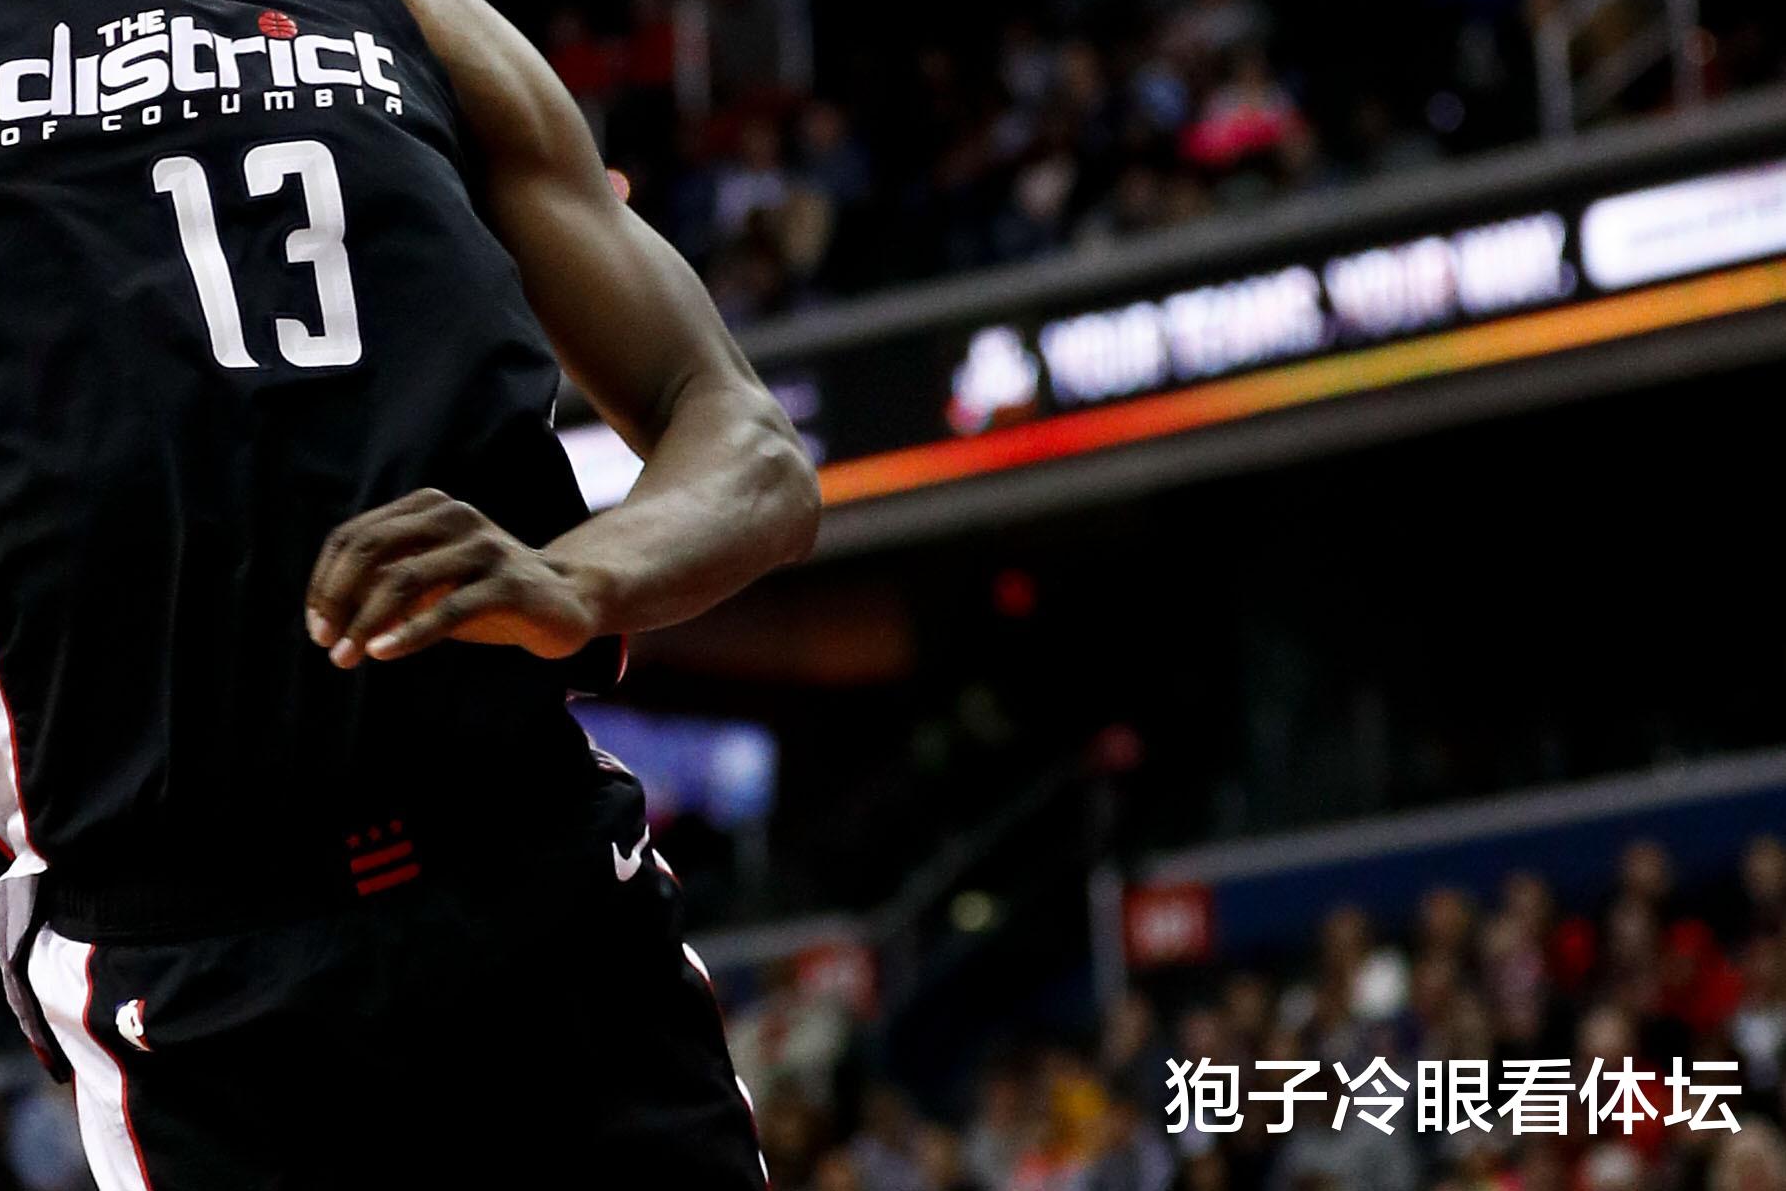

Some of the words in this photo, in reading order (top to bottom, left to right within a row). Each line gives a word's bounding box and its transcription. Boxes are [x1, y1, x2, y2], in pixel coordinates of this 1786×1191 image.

[97, 9, 166, 48] THE
[0, 120, 58, 146] OF
[102, 87, 404, 132] COLUMBIA
[151, 140, 363, 369] 13
